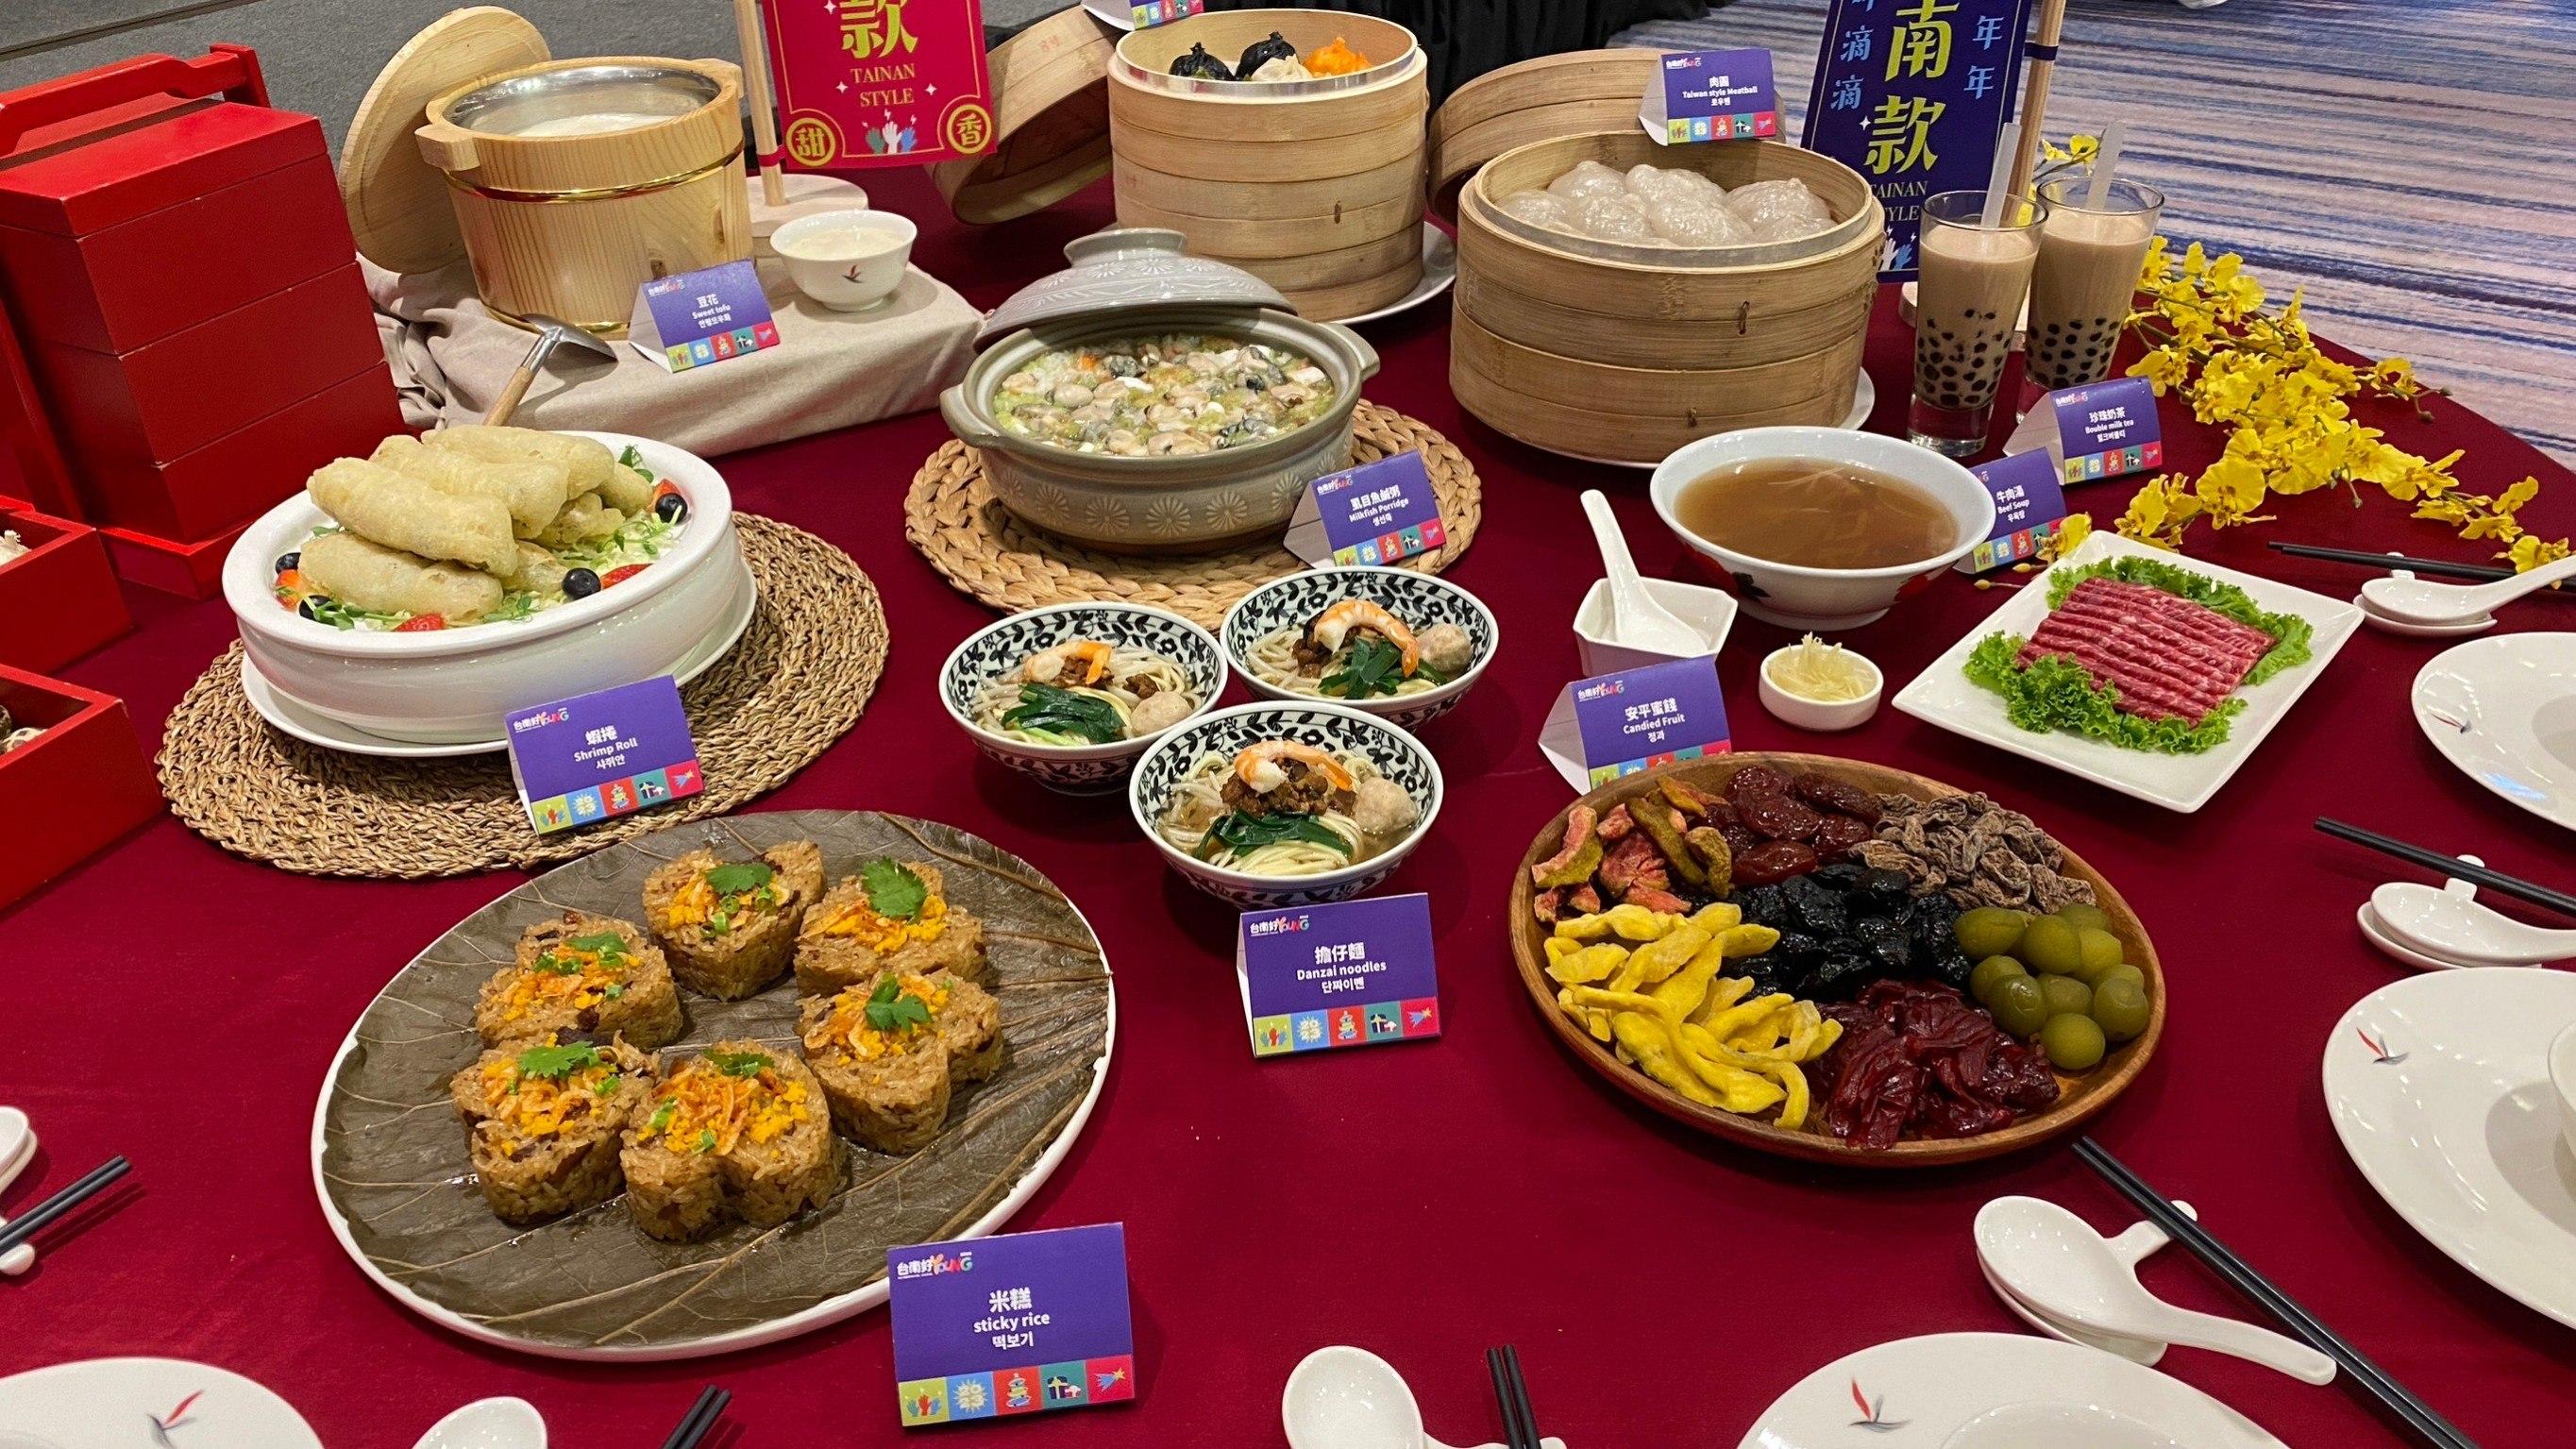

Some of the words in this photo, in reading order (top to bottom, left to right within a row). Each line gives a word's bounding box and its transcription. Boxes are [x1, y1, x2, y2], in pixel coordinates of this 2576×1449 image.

[839, 0, 918, 59] 款
[850, 63, 916, 83] TAINAN
[860, 89, 915, 107] STYLE
[1709, 89, 1726, 97] style
[1726, 86, 1759, 94] Meatball
[956, 112, 982, 146] 香
[796, 126, 826, 158] 甜
[1884, 205, 1920, 222] YLE
[697, 294, 719, 309] 豆花
[692, 308, 716, 319] Sweet
[715, 304, 732, 313] tofu
[2088, 407, 2126, 423] 珍珠奶茶
[2108, 421, 2123, 430] milk
[1349, 507, 1378, 522] Milkfish
[1378, 498, 1409, 513] Porridge
[1997, 502, 2012, 514] Beef
[2012, 499, 2029, 509] Soup
[1624, 718, 1661, 734] Candied
[1663, 713, 1685, 726] Fruit
[574, 746, 614, 762] Shrimp
[615, 737, 638, 750] Roll
[1297, 964, 1337, 980] Danzai
[1339, 961, 1388, 976] noodles
[989, 1287, 1033, 1312] 米糕
[973, 1315, 1019, 1333] sticky
[1021, 1312, 1050, 1326] rice
